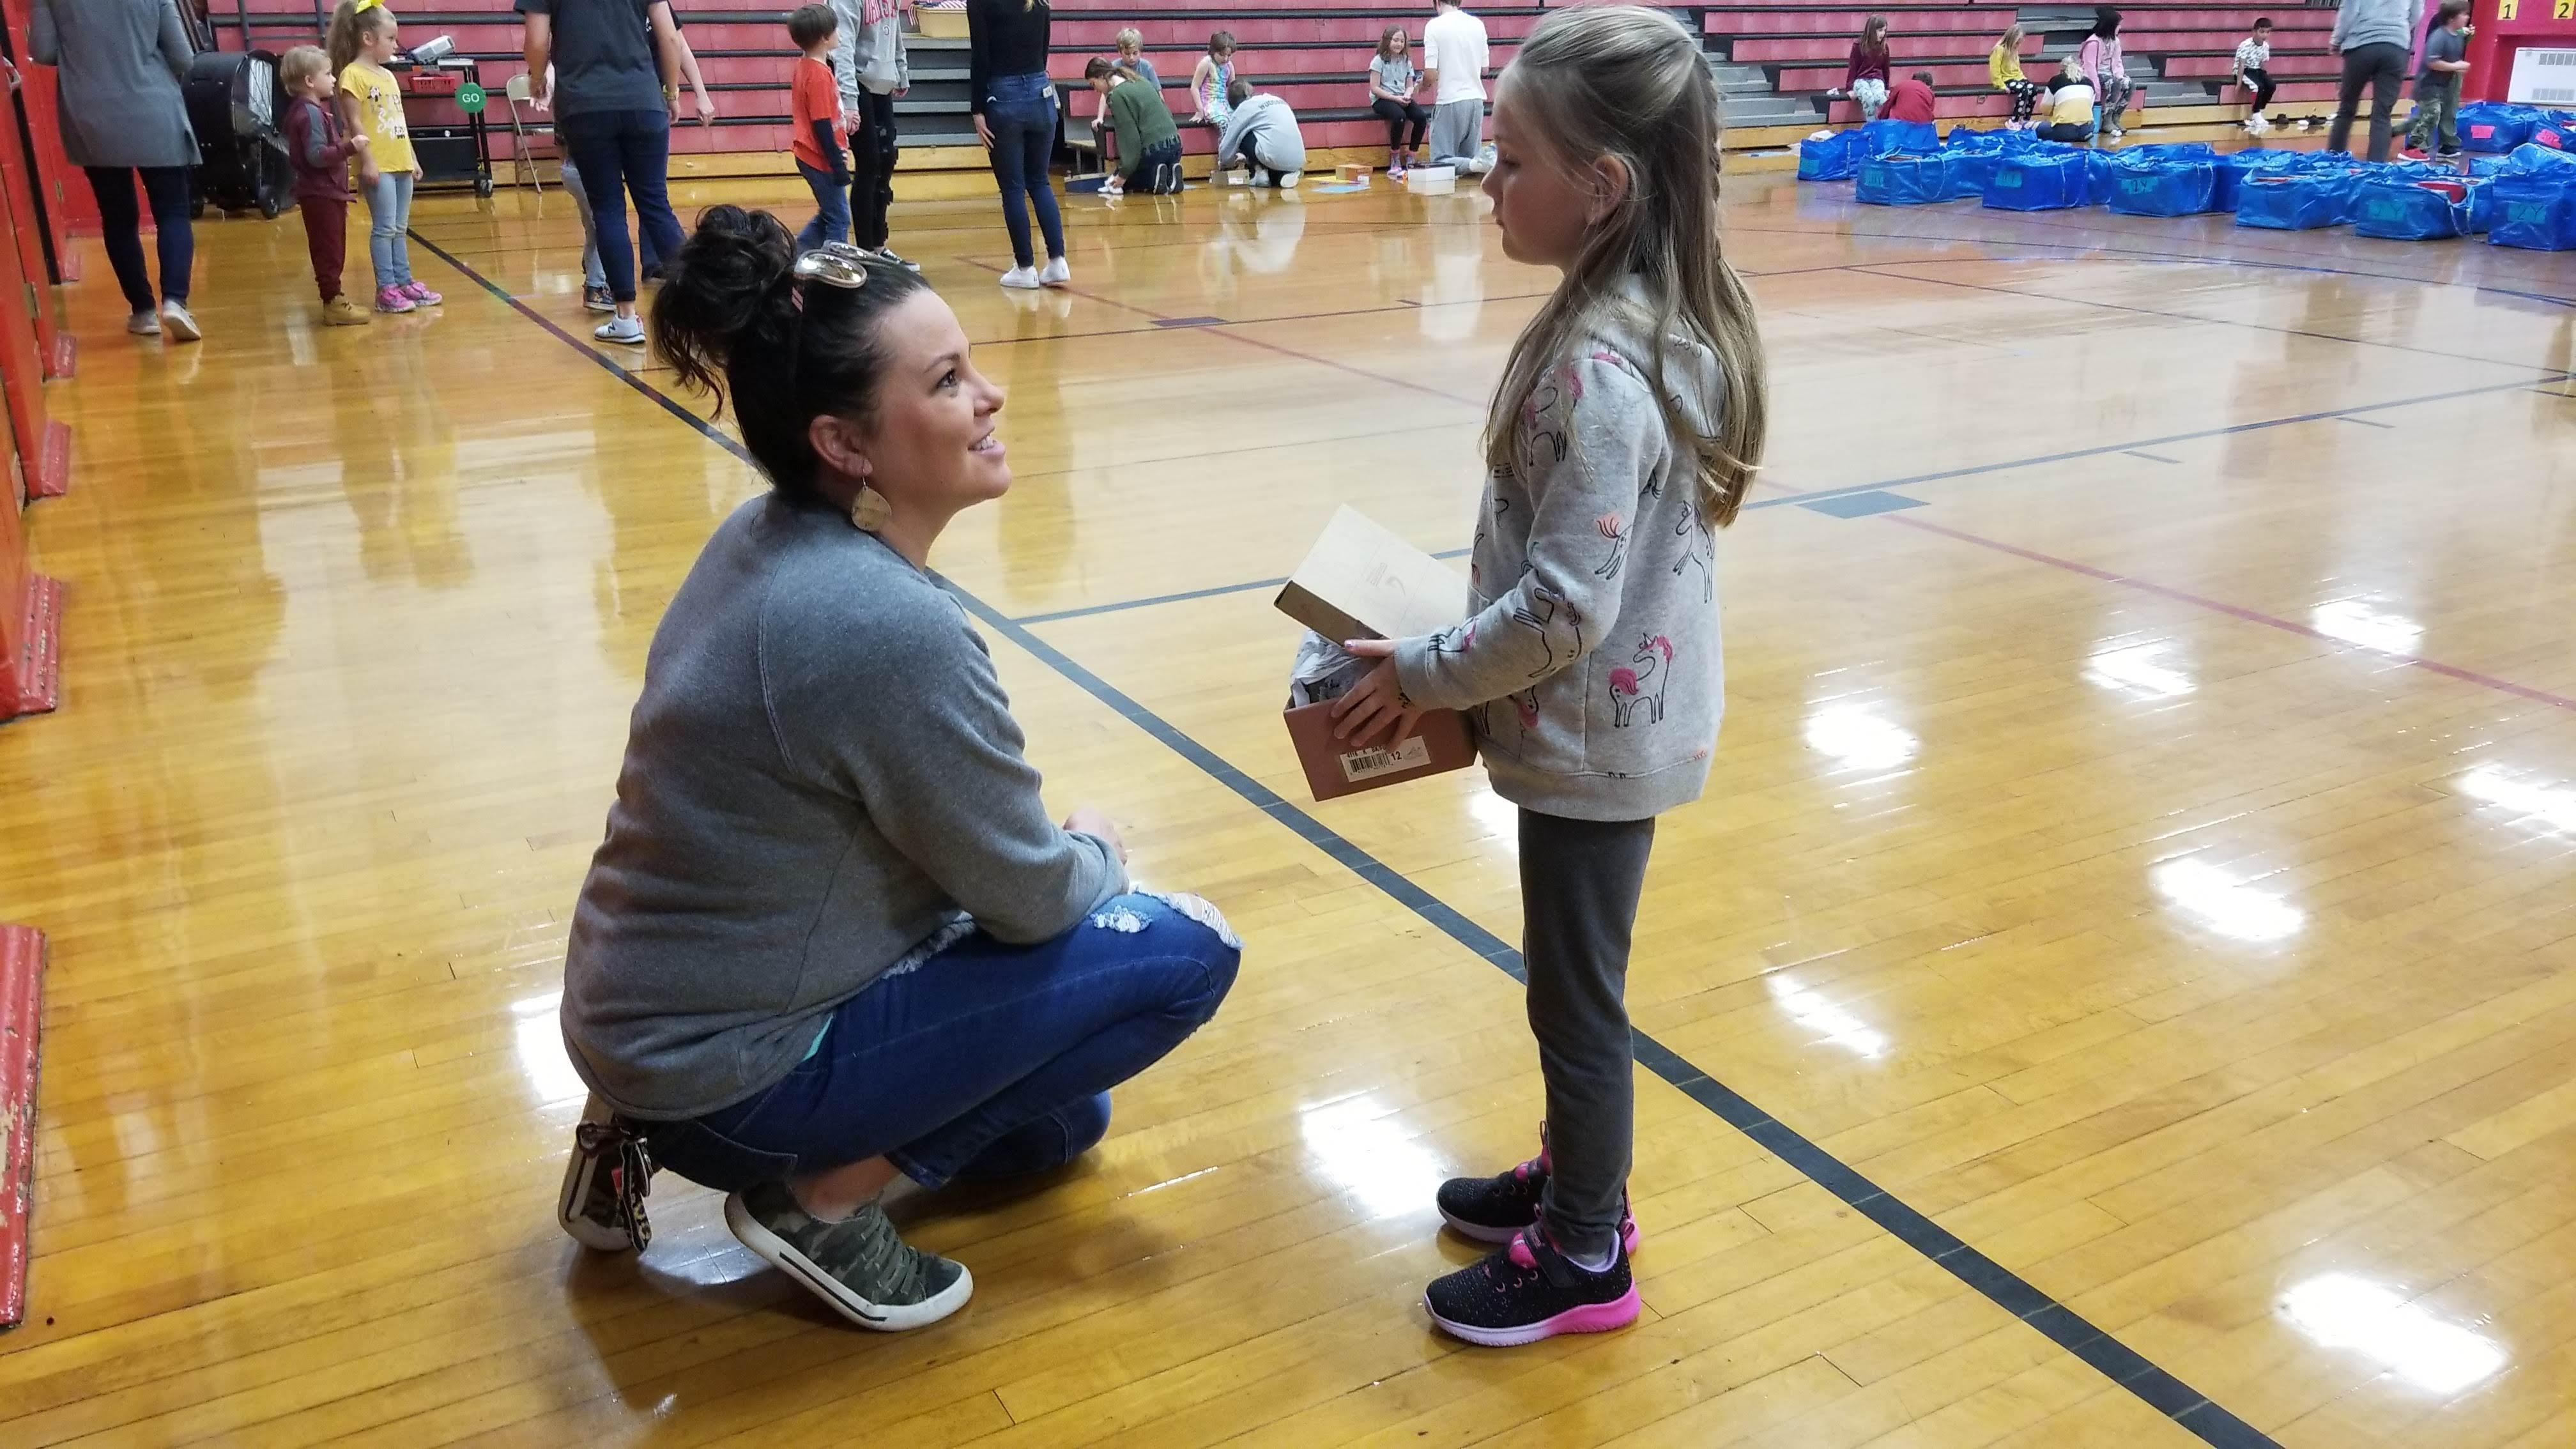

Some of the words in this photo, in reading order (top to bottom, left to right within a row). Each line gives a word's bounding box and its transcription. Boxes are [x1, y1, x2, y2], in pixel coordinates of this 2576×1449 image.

[2503, 3, 2511, 19] 1
[2558, 2, 2570, 19] 2
[462, 93, 480, 103] GO
[2517, 204, 2544, 220] 2Y
[1391, 751, 1402, 761] 12
